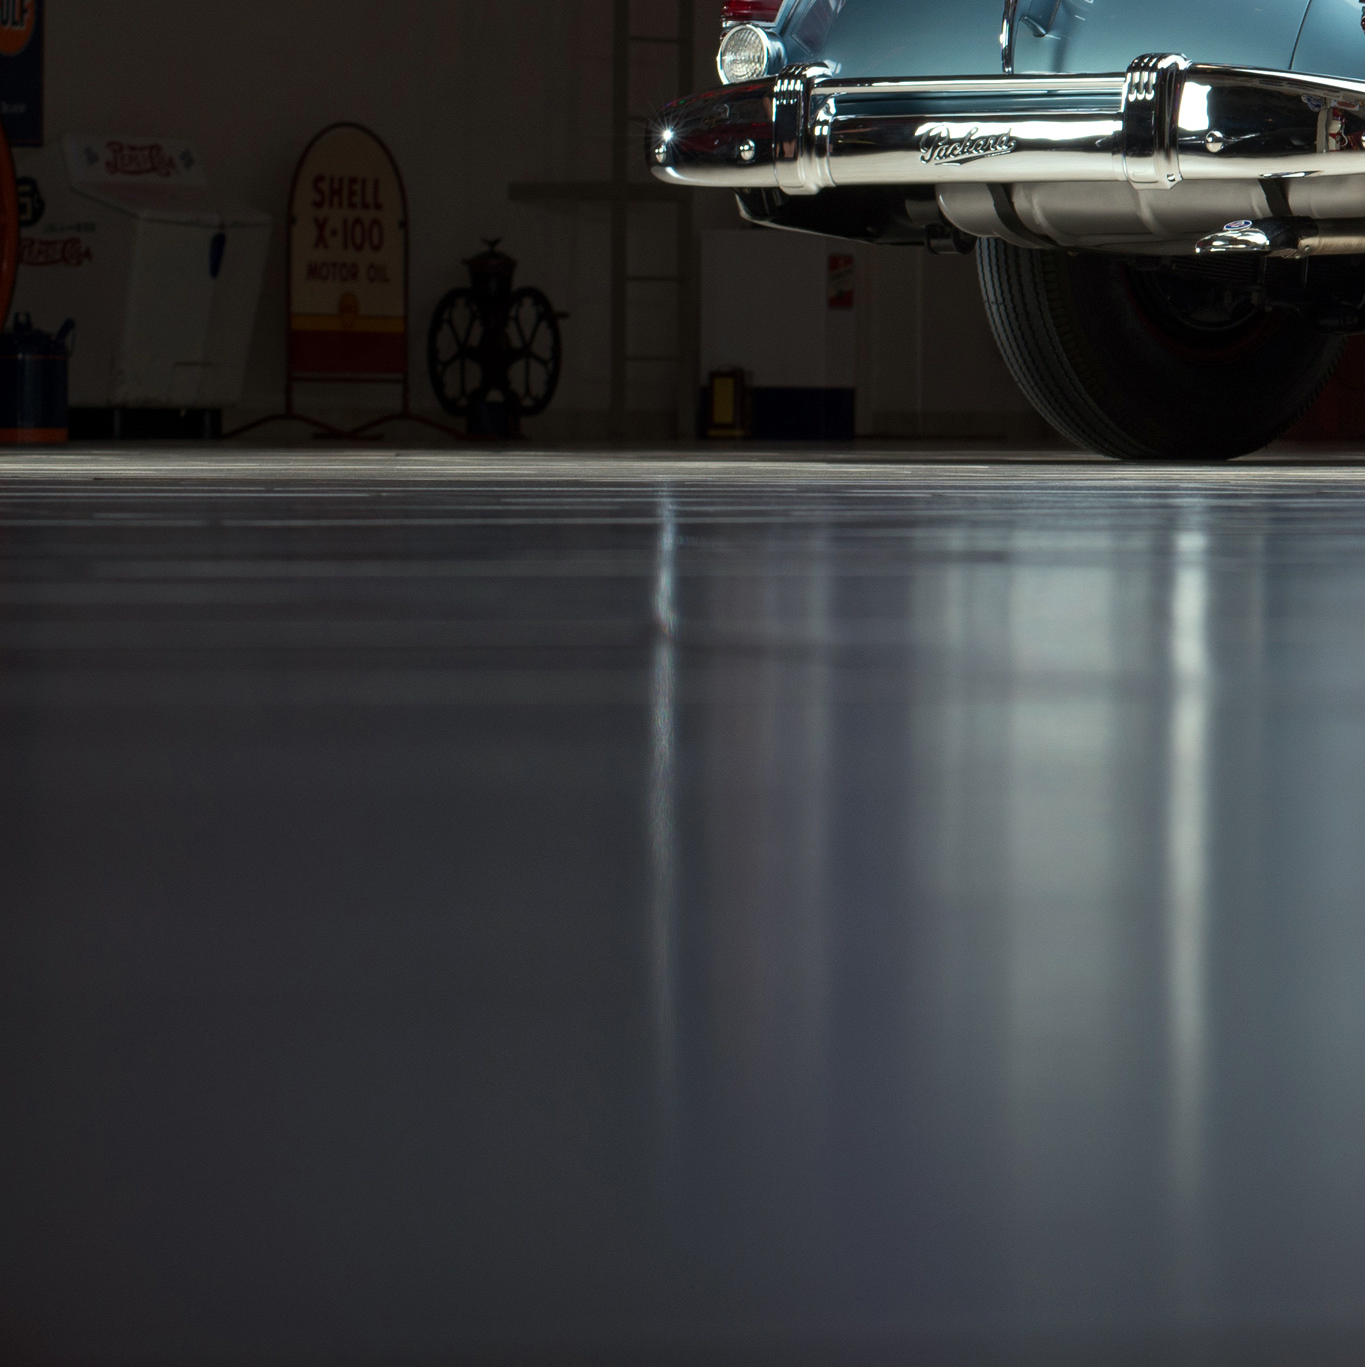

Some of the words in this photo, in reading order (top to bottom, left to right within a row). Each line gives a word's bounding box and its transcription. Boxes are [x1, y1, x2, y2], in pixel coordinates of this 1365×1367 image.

[920, 124, 1017, 165] Packard
[312, 175, 383, 210] SHELL
[306, 261, 360, 284] MOTOR
[366, 263, 391, 284] OIL
